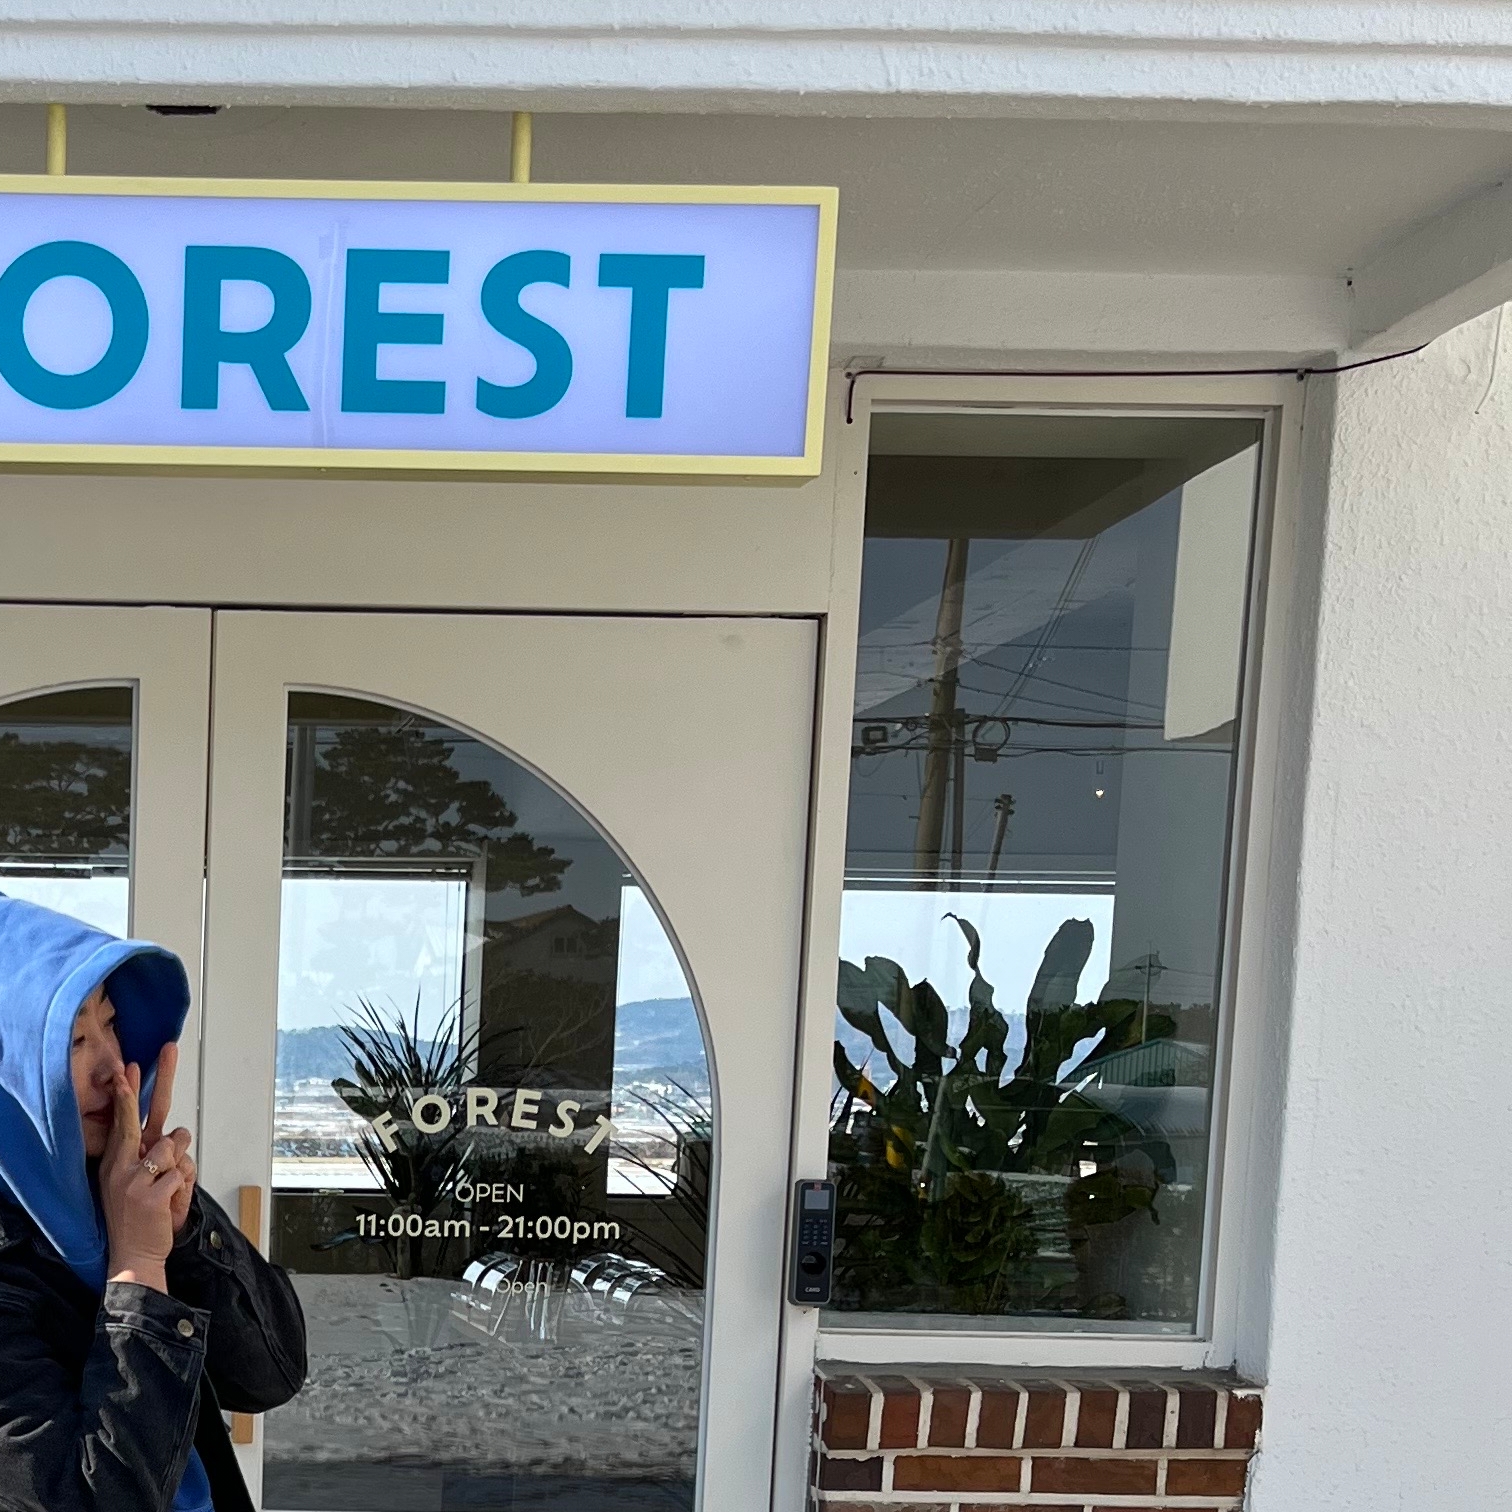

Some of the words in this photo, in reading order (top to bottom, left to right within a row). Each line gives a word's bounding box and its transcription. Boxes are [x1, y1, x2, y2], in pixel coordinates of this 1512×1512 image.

[372, 1087, 619, 1154] FOREST
[455, 1183, 524, 1203] OPEN
[356, 1213, 470, 1237] 11:00am
[497, 1215, 620, 1244] 21:00pm
[496, 1278, 548, 1297] Open
